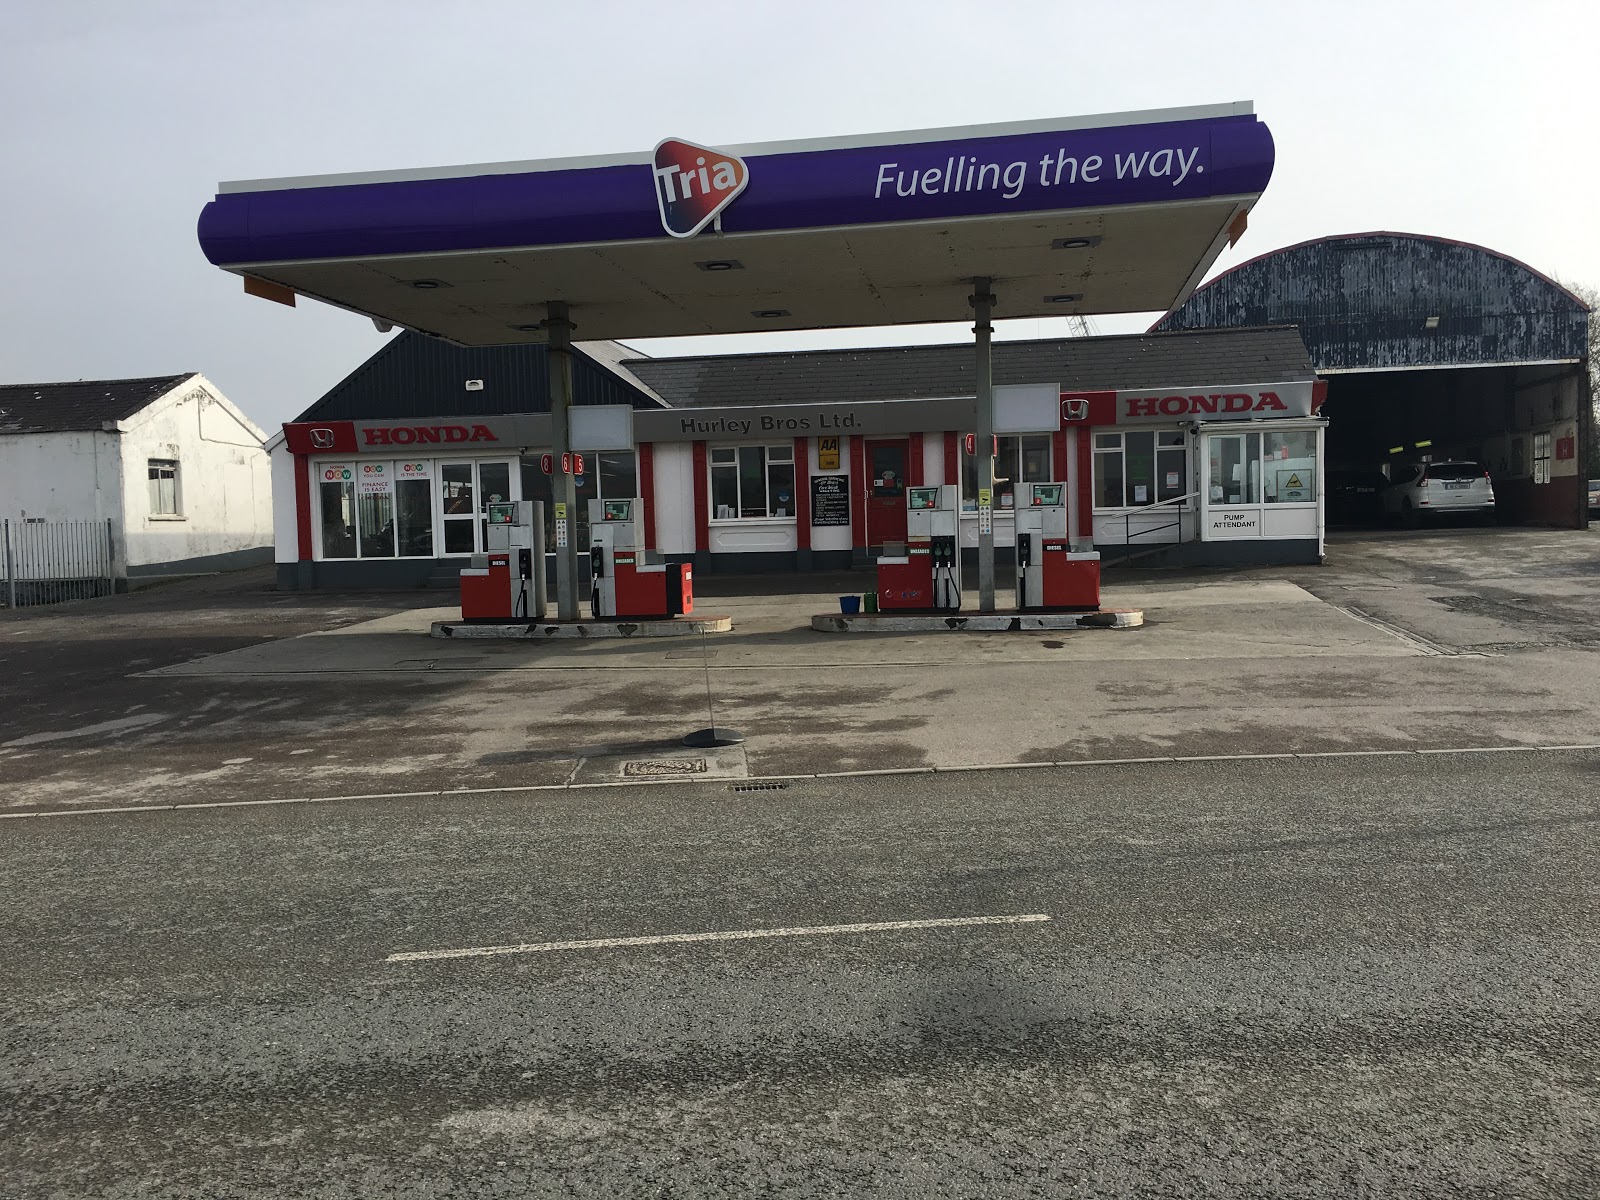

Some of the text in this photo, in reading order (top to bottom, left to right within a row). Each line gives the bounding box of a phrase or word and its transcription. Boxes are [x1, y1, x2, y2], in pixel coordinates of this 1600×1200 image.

[656, 157, 738, 203] Tria
[874, 146, 1205, 200] Fuelling the way.
[1125, 392, 1287, 416] HONDA
[680, 412, 863, 435] Hurley Bros Ltd.
[362, 425, 498, 446] HONDA
[820, 439, 837, 451] AA
[325, 470, 351, 480] NOW
[364, 465, 383, 473] NOW
[404, 464, 423, 472] NOW
[1213, 521, 1257, 529] ATTENDANT
